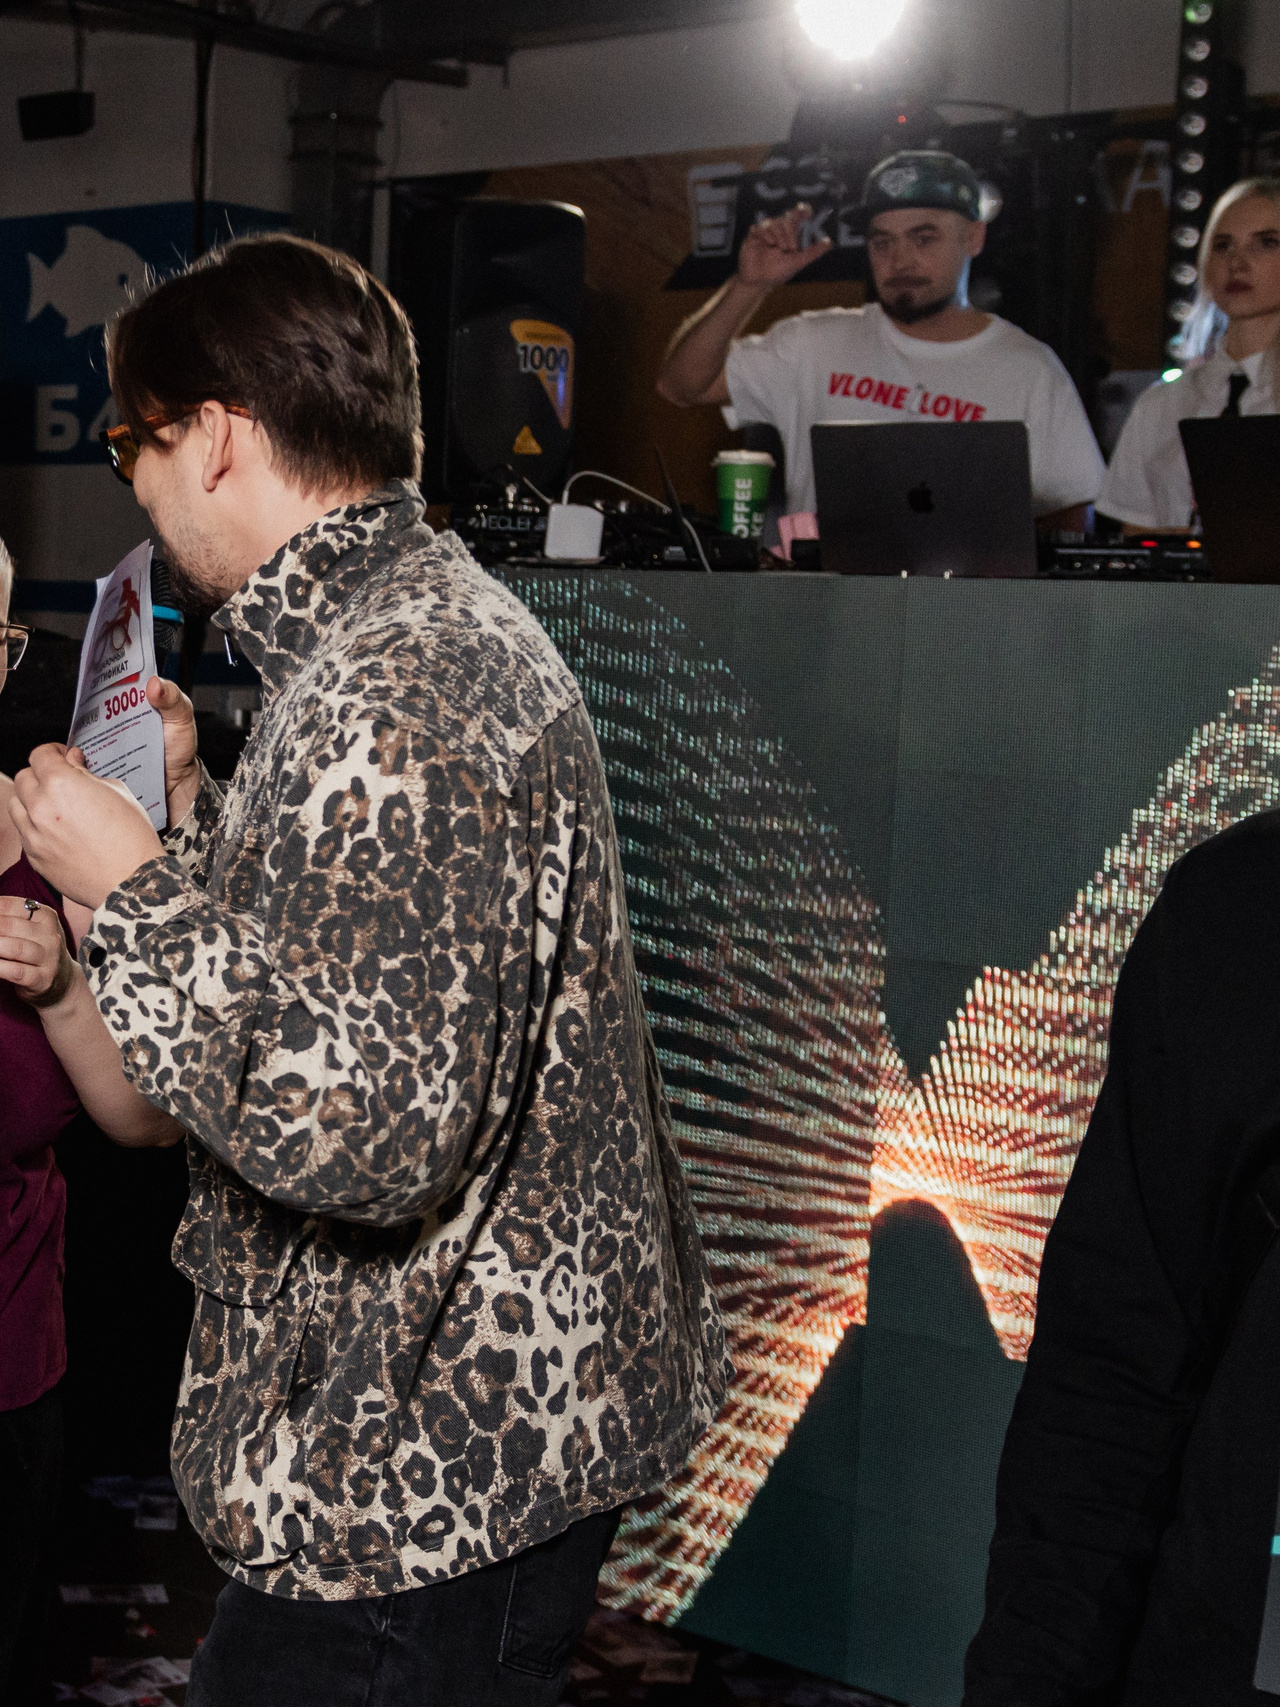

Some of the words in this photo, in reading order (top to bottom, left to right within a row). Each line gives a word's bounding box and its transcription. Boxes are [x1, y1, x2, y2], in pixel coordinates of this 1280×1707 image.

[519, 343, 570, 372] 1000
[828, 372, 910, 410] VLONE
[919, 390, 987, 422] LOVE
[732, 478, 752, 539] OFFEE
[751, 511, 766, 538] KE
